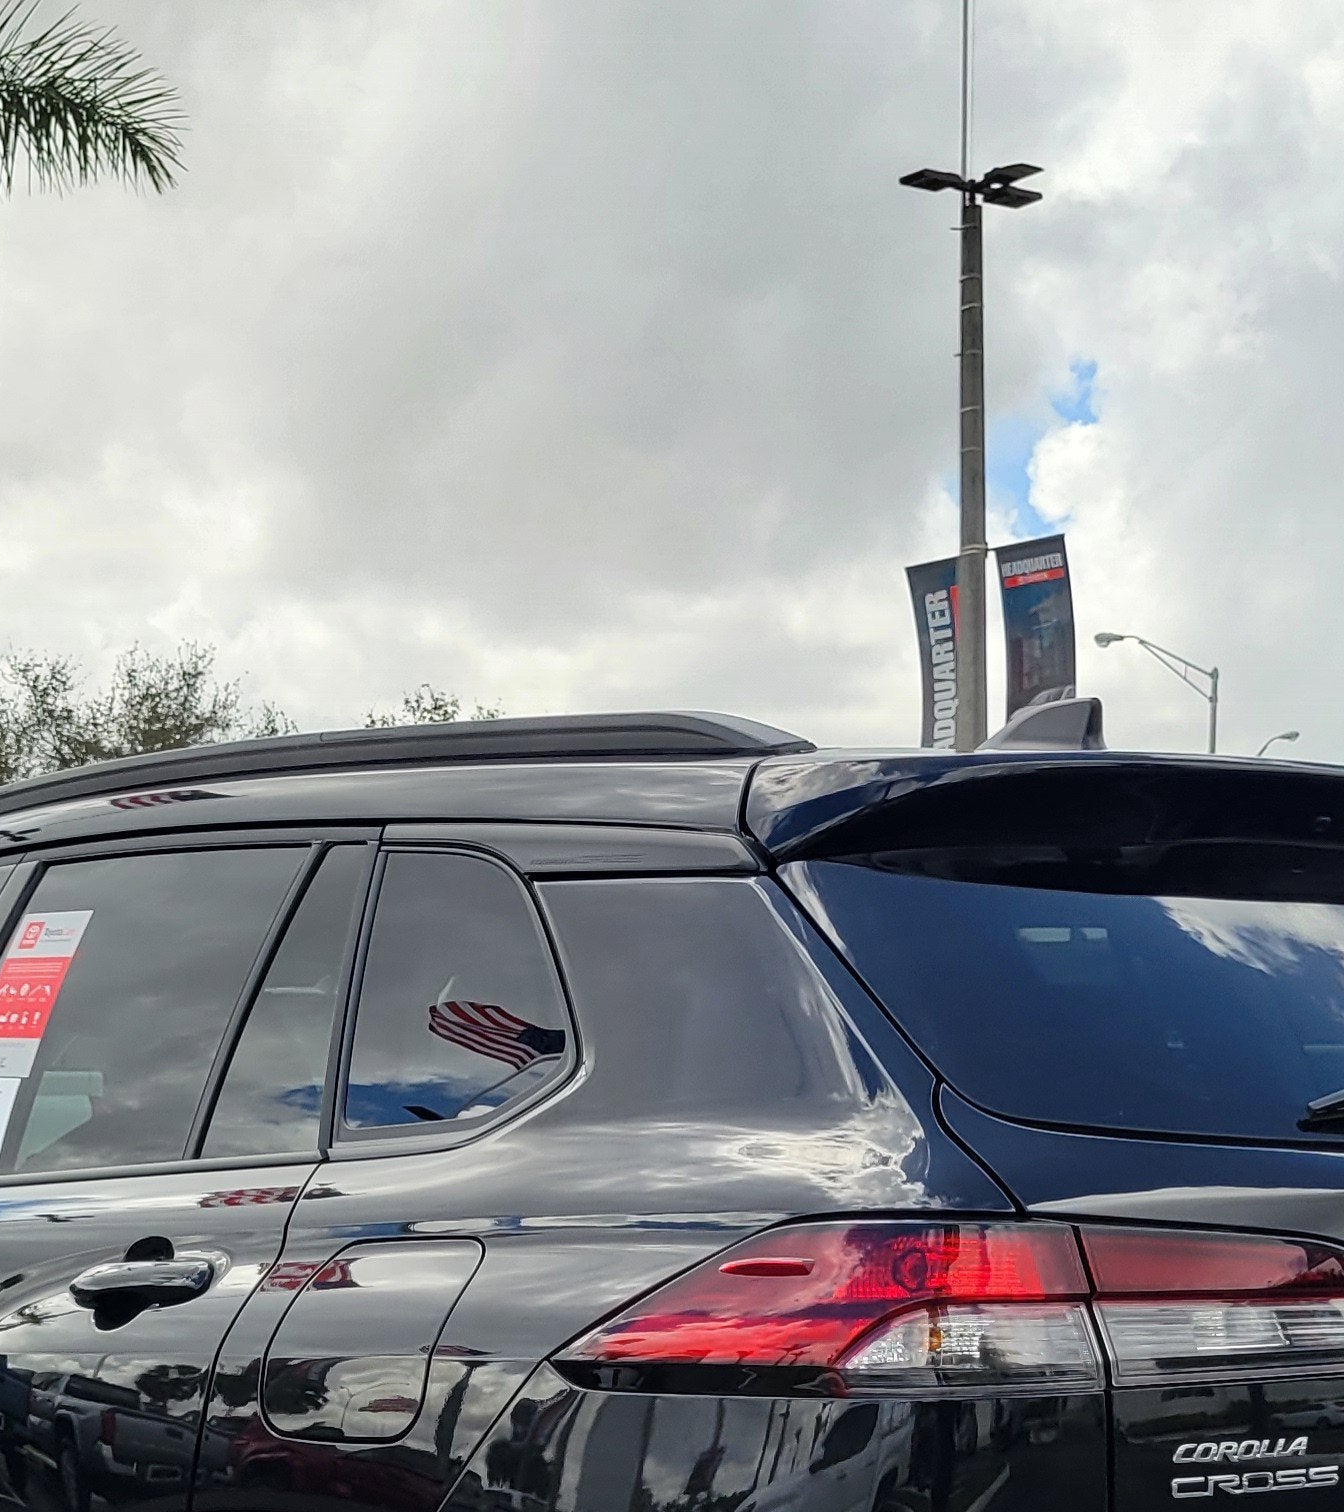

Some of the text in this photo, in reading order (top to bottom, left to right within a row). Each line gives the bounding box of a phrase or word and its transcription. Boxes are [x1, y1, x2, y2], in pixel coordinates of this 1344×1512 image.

[925, 589, 960, 750] ADQUARTER
[1172, 1436, 1309, 1464] COROLLA
[1171, 1465, 1340, 1499] CROSS
